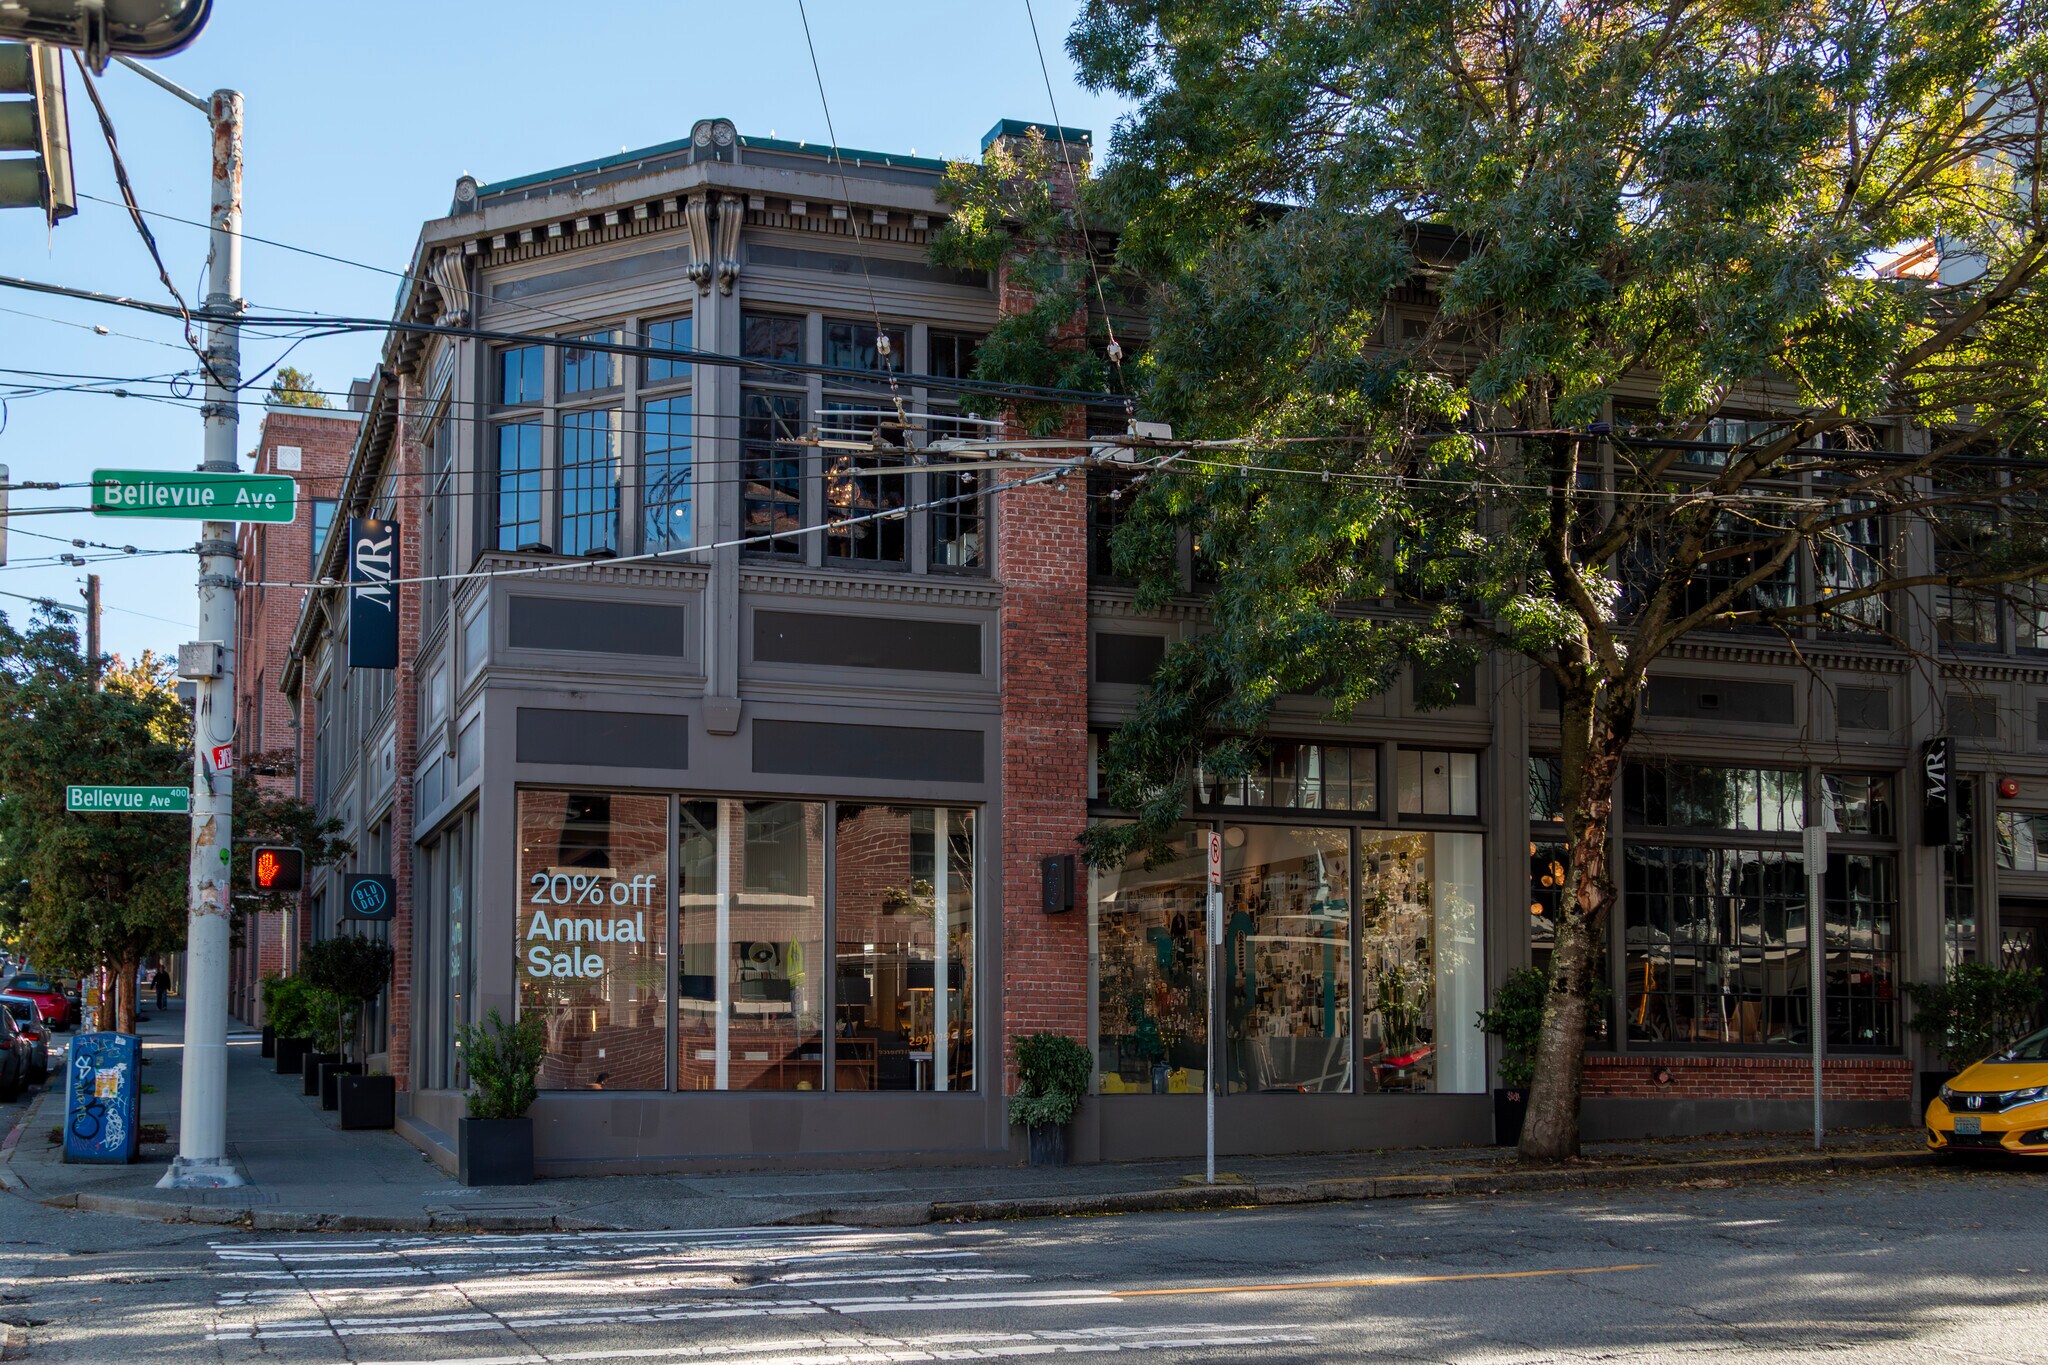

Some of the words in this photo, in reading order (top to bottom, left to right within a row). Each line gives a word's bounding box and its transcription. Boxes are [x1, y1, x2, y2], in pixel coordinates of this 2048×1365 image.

[104, 479, 215, 507] Bellevue
[234, 487, 276, 510] Ave
[356, 525, 392, 612] MR.
[71, 788, 143, 807] Bellevue
[149, 795, 171, 807] Ave
[170, 789, 187, 797] 400
[356, 884, 377, 900] BLU
[360, 894, 380, 910] DOT
[530, 873, 604, 905] 20%
[609, 874, 657, 906] off
[526, 910, 646, 943] Annual
[527, 945, 604, 978] Sale
